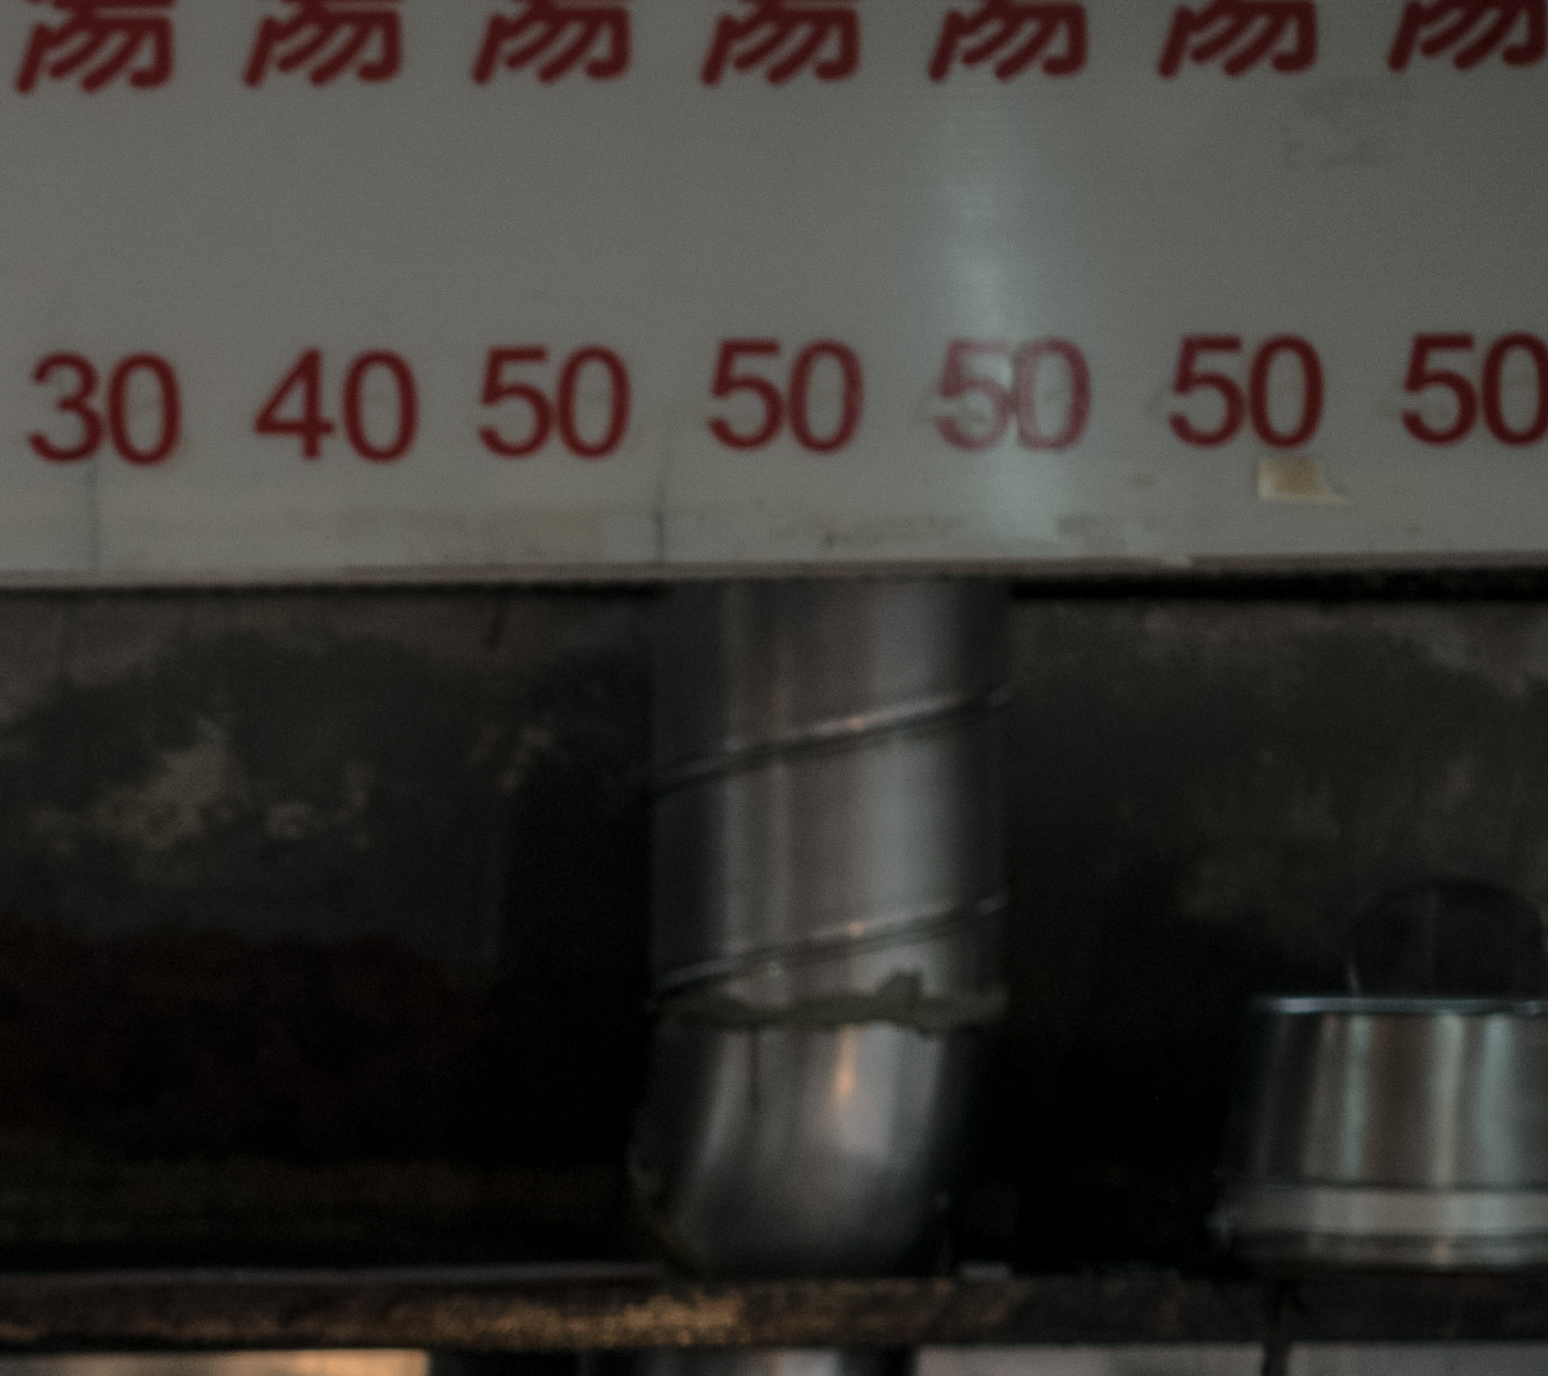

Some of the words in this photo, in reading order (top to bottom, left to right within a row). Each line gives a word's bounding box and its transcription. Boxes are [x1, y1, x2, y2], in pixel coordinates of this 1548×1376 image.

[28, 352, 183, 467] 30
[253, 348, 420, 464] 40
[478, 346, 632, 460] 50
[709, 339, 863, 453] 50
[936, 336, 1094, 452] 50
[1169, 335, 1324, 449] 50
[1401, 333, 1548, 446] 50
